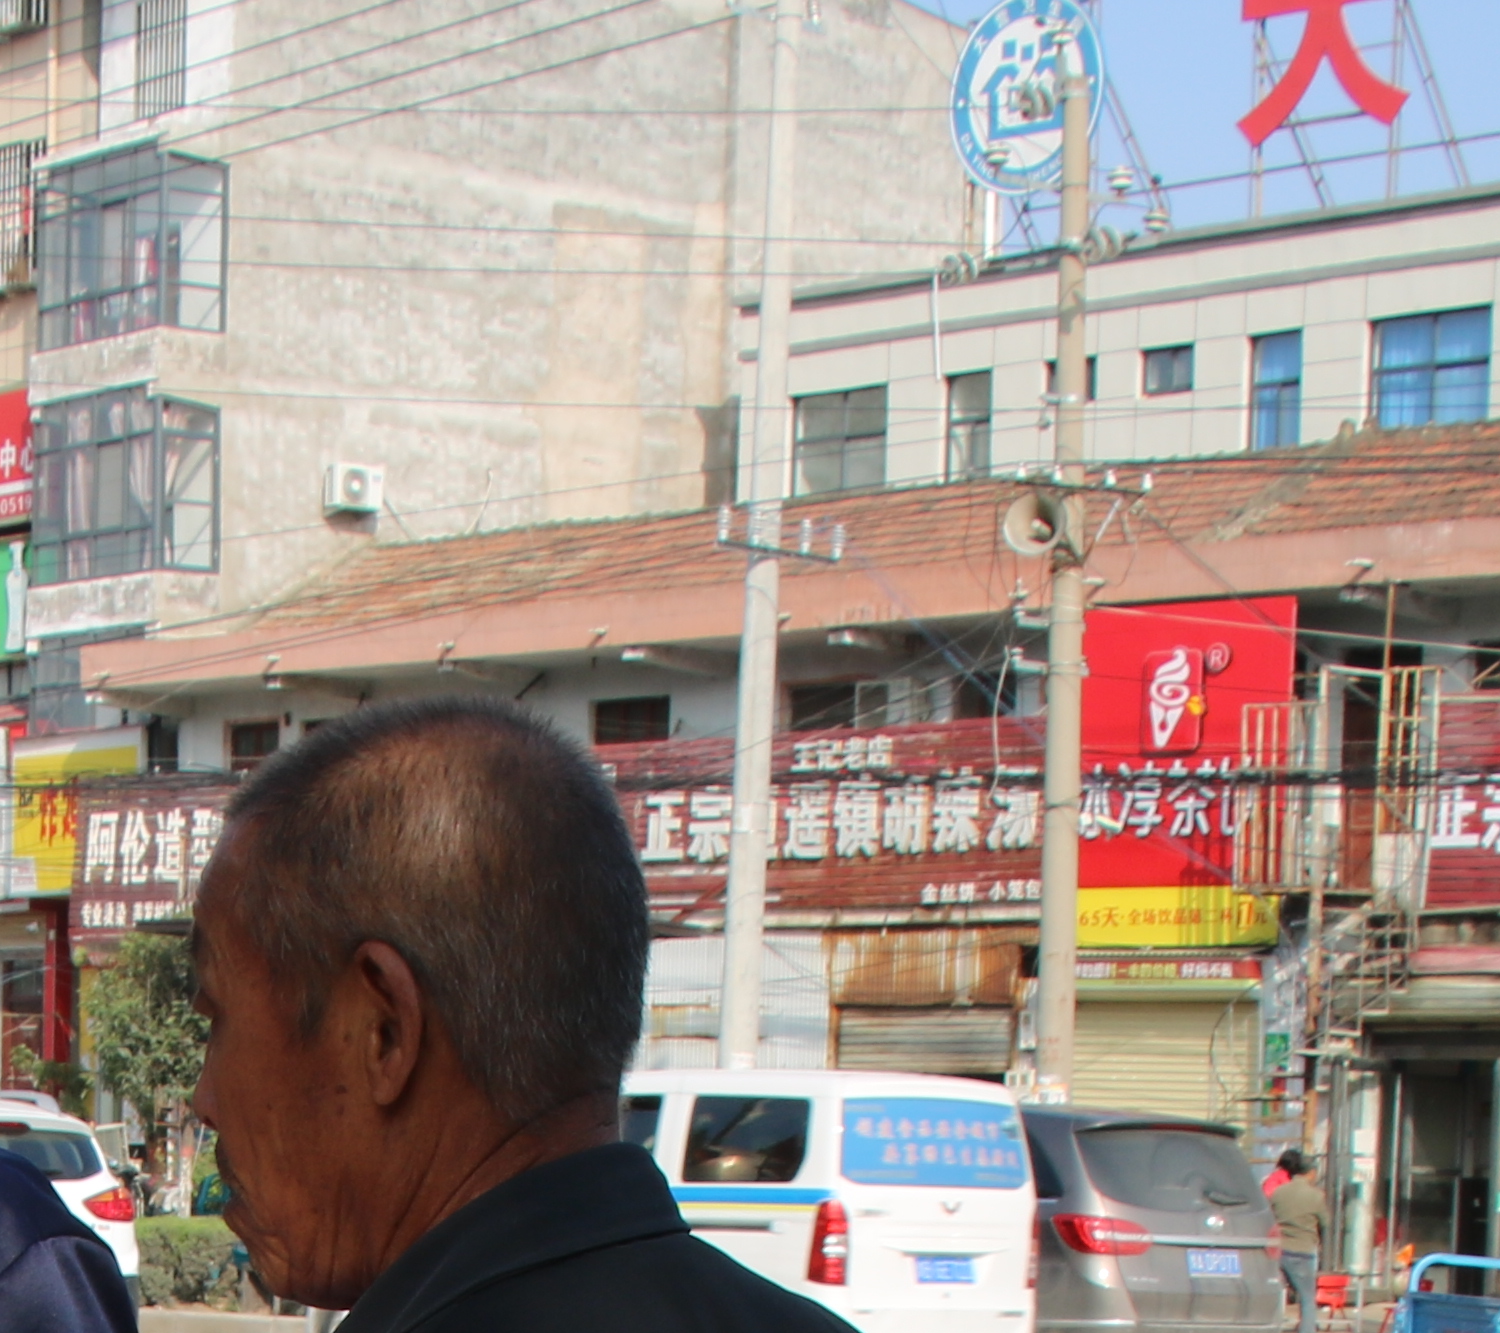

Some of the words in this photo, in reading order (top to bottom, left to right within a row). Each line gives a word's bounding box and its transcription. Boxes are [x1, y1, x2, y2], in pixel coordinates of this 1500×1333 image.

[789, 734, 894, 774] 王记老店
[640, 766, 1042, 863] 正宗遥镇胡辣汤
